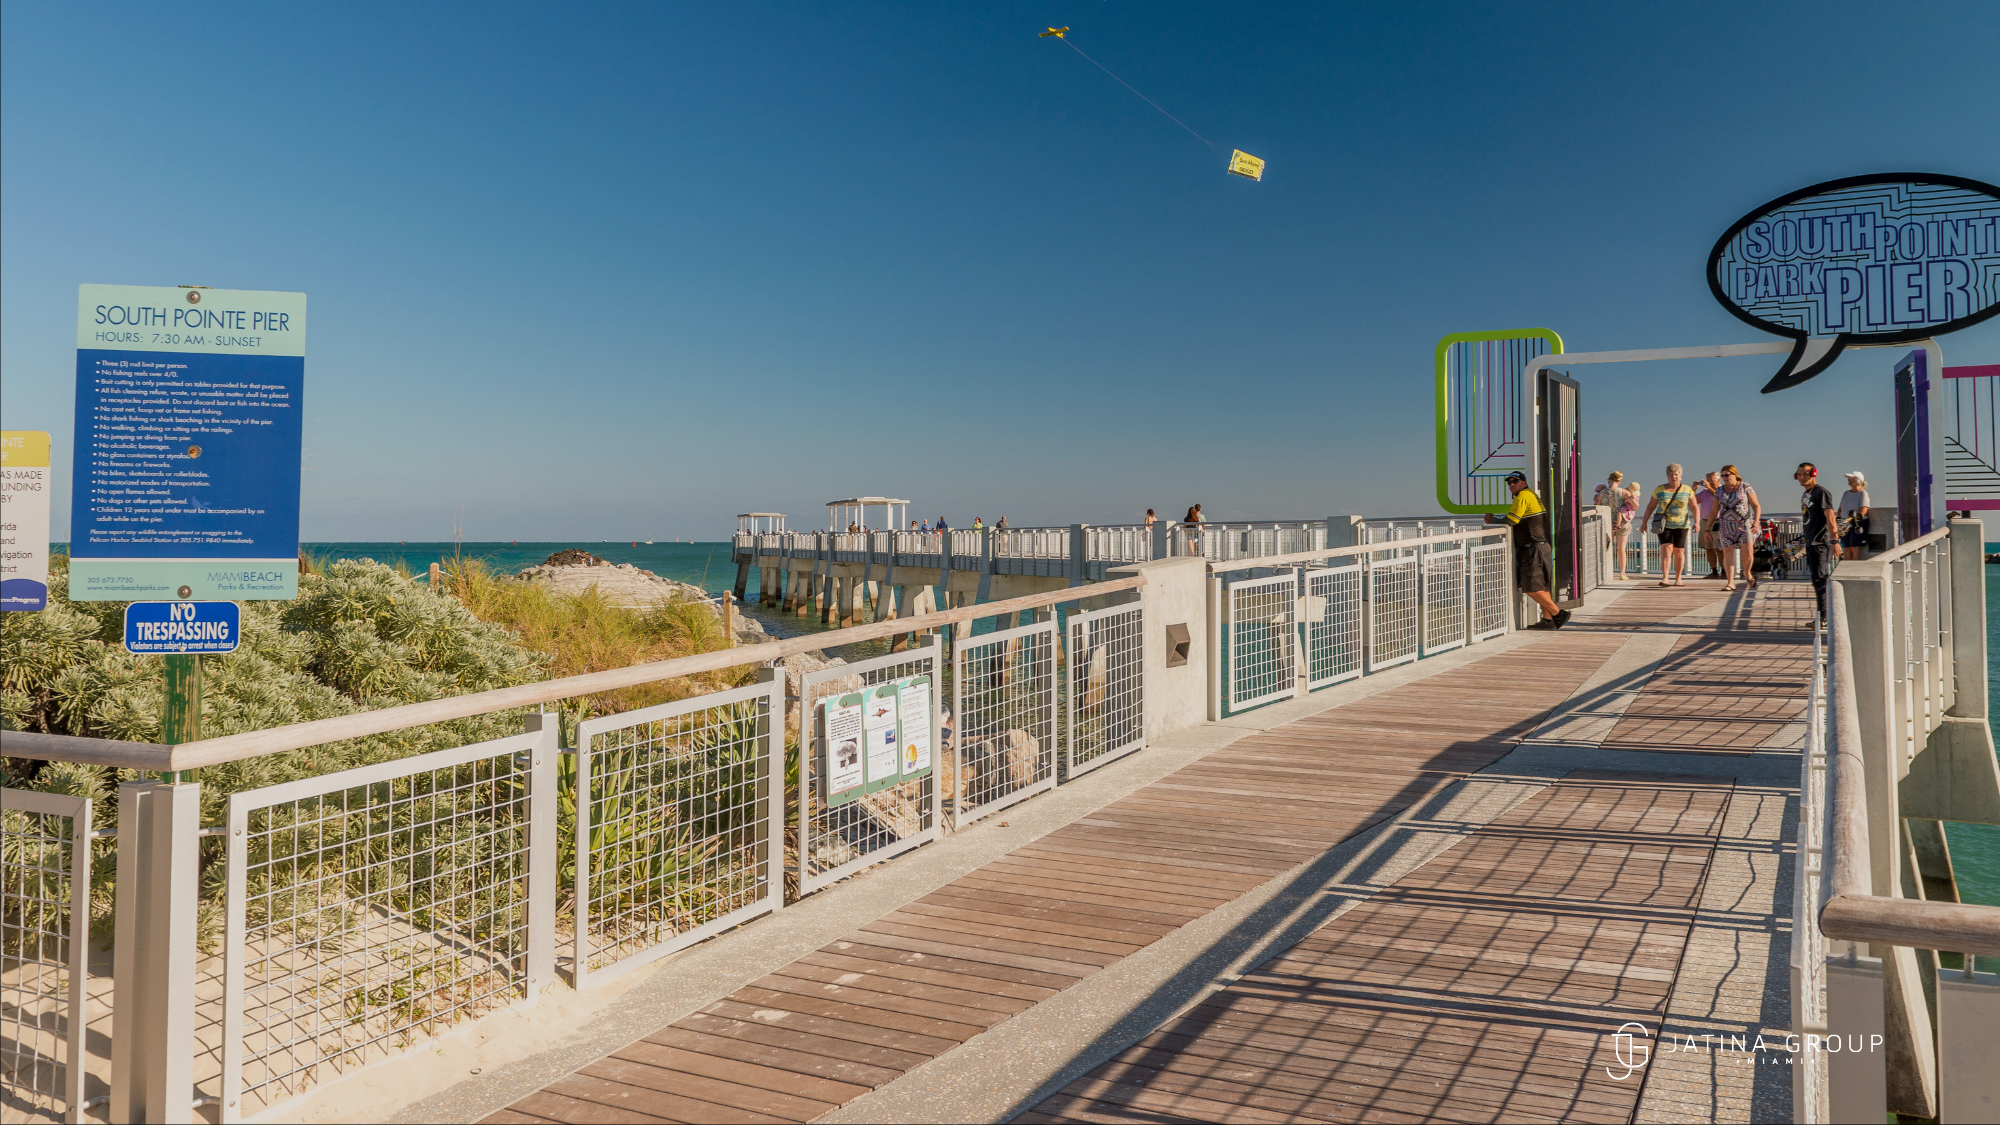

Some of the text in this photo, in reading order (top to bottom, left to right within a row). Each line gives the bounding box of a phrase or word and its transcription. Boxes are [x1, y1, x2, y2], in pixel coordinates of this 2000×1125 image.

[1746, 211, 1876, 259] SOUTH
[1736, 259, 1971, 328] PARK PIER
[95, 305, 290, 332] SOUTH POINTE PIER
[96, 331, 262, 347] HOURS: 7:30 AM SUNSET
[122, 388, 148, 396] cleaning
[202, 408, 223, 416] fishing.
[129, 415, 148, 423] fishing
[111, 424, 136, 432] walking,
[144, 434, 163, 442] diving
[138, 443, 171, 451] beverages.
[14, 471, 42, 480] MADE
[1, 494, 13, 503] BY
[170, 603, 196, 622] NO
[136, 621, 229, 641] TRESPASSING
[130, 642, 153, 650] Violators
[163, 642, 181, 652] subject
[186, 642, 203, 650] arrest
[204, 641, 218, 649] when
[218, 640, 234, 649] closed
